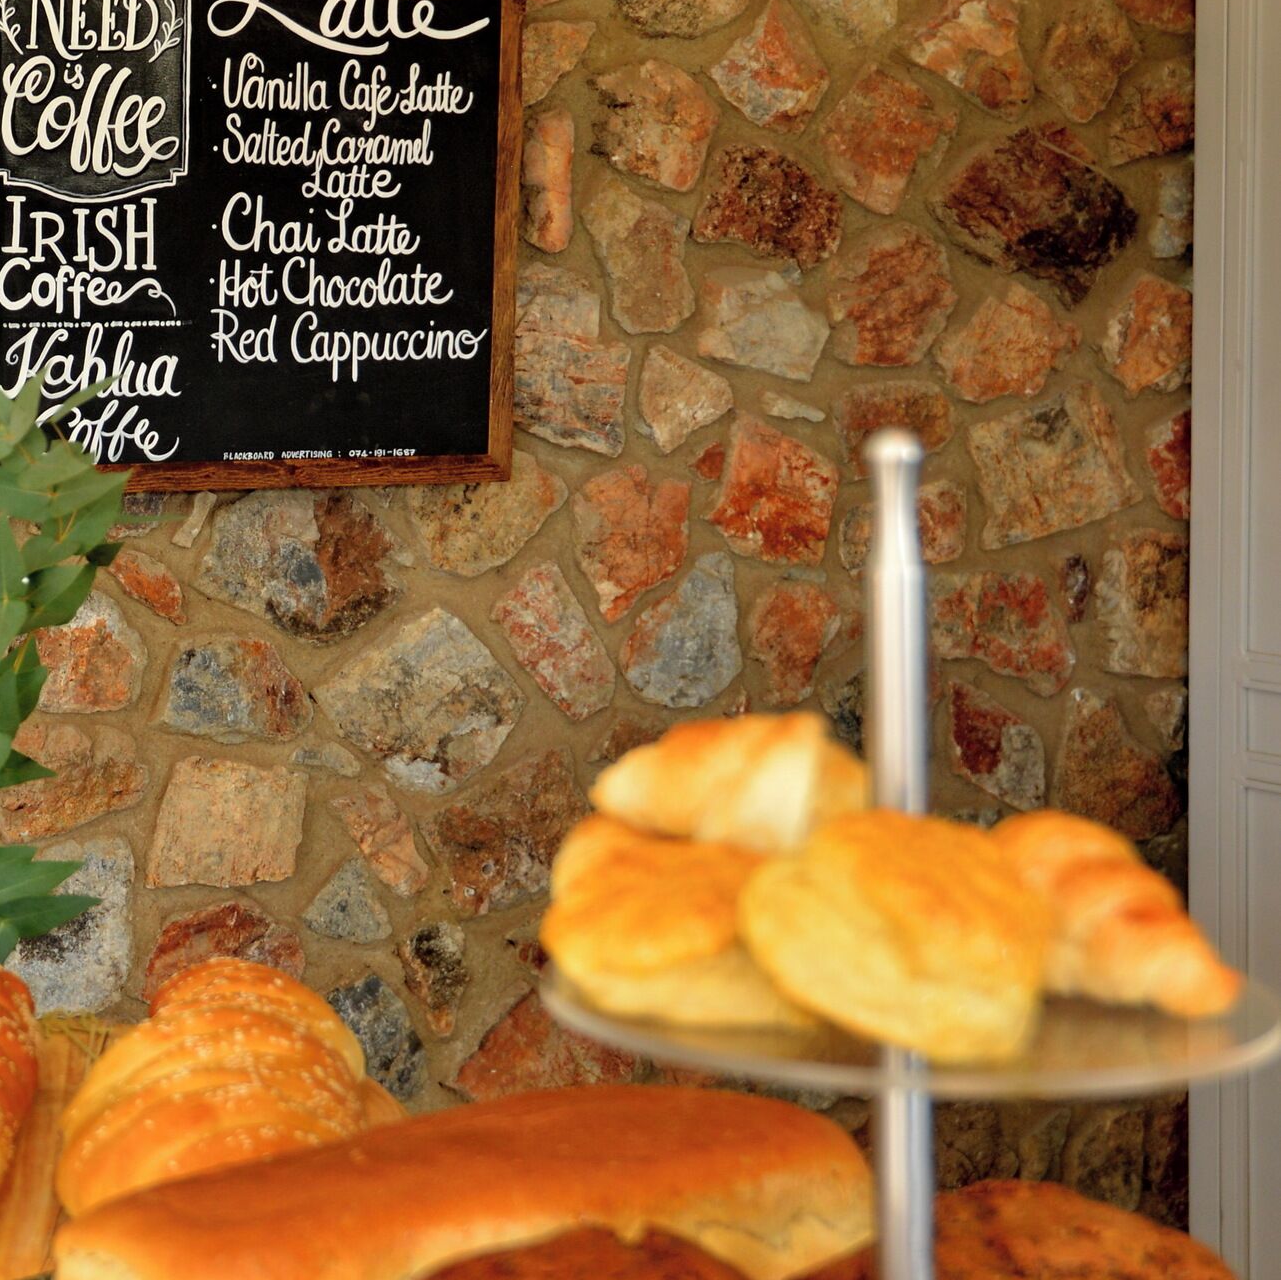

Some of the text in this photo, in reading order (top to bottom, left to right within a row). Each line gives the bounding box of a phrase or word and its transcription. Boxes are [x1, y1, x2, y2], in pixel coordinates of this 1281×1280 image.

[63, 62, 84, 89] is
[223, 52, 474, 131] Vanilla Cafe Latte
[1, 55, 179, 177] Coffee
[223, 113, 434, 166] Salted Caramel
[302, 149, 402, 198] Latte
[1, 195, 157, 272] IRISH
[221, 191, 421, 254] Chai Latte
[219, 256, 454, 308] Hot Chocolate
[0, 322, 183, 400] Kahlua
[210, 308, 488, 383] Red Cappuccino
[223, 451, 275, 461] BLACKBOARD
[281, 449, 333, 459] ADVERTISING
